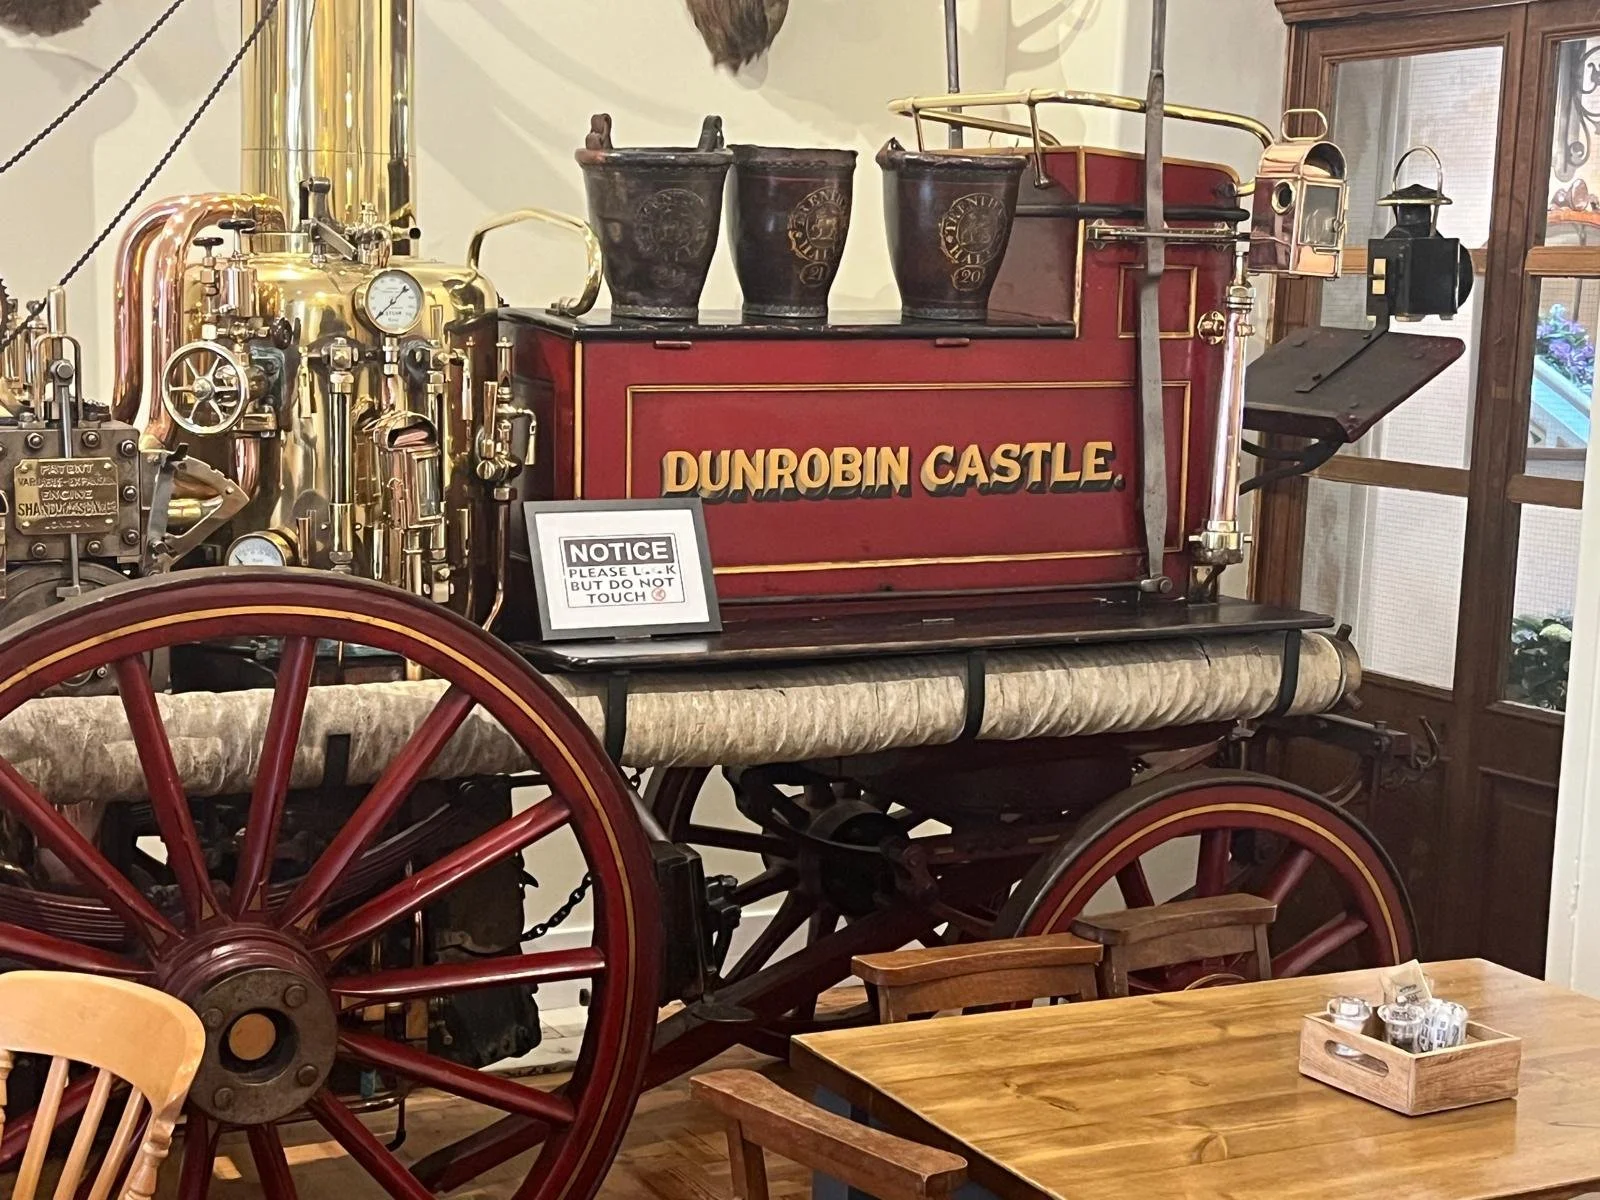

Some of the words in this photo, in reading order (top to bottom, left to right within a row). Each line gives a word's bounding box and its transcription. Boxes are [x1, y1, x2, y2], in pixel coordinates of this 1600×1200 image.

[960, 269, 981, 283] 20
[40, 464, 94, 475] PATENT
[662, 445, 909, 500] DUNROBIN
[921, 441, 1125, 493] CASTLE.
[41, 489, 94, 501] ENGINE
[569, 541, 669, 563] NOTICE
[568, 566, 628, 578] PLEASE
[571, 580, 603, 592] BUT
[609, 579, 633, 590] DO
[639, 577, 675, 589] NOT
[586, 591, 646, 604] TOUCH
